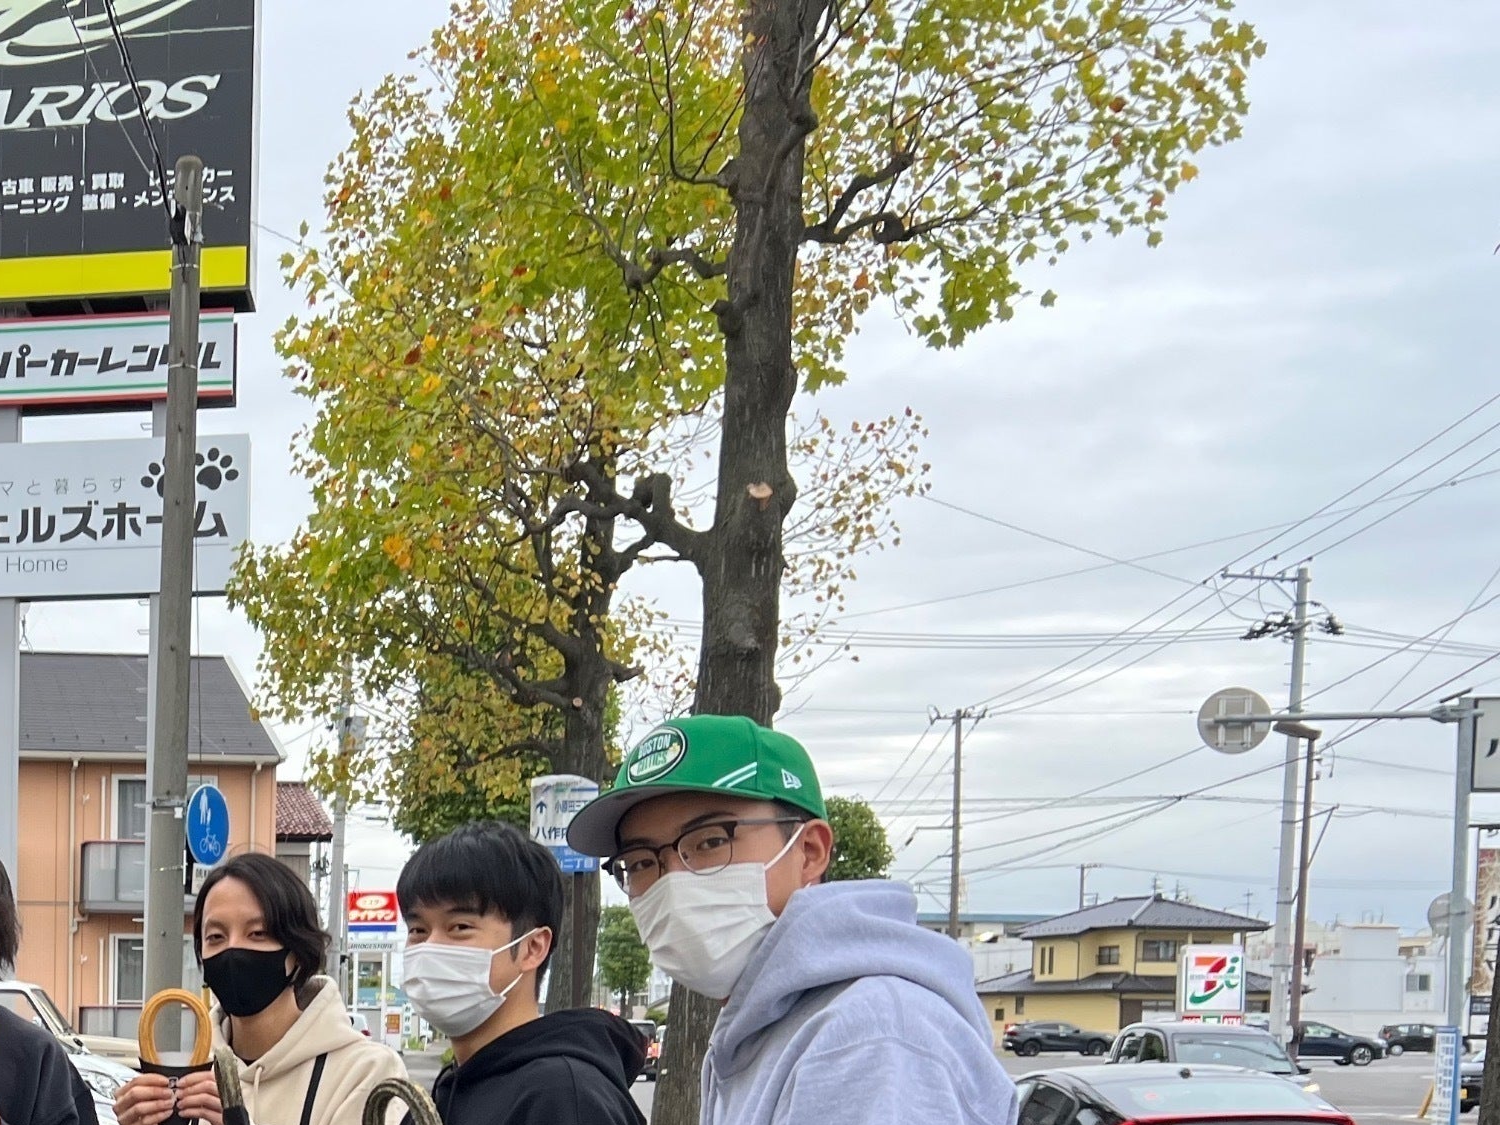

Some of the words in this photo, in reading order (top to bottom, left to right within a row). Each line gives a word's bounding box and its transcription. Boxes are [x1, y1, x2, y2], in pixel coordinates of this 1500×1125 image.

[149, 168, 233, 191] レンカー
[5, 555, 69, 574] Home
[637, 733, 672, 759] BOSTON
[560, 857, 594, 869] 二丁目
